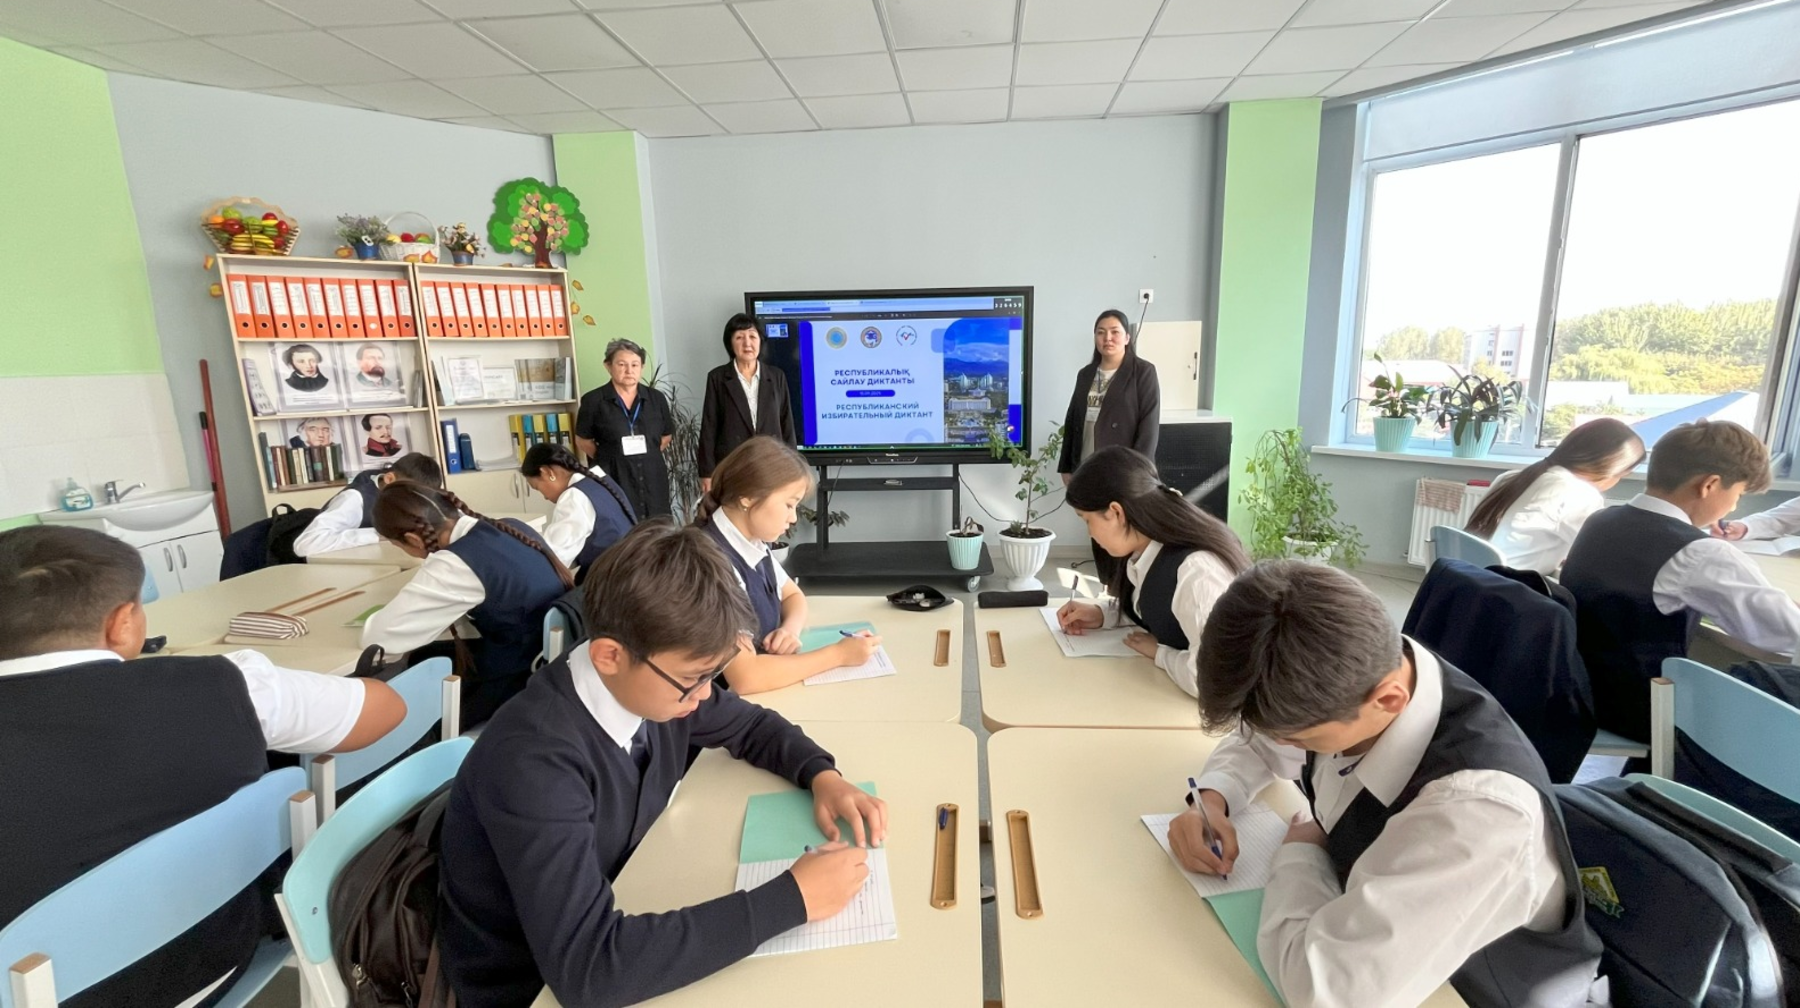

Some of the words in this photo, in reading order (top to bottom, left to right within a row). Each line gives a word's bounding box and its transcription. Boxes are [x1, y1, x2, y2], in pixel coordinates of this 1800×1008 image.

[836, 402, 919, 410] РЕСПУБЛИКАНСКИЙ
[821, 411, 893, 419] ИЗБИРАТЕЛЬНЫЙ
[894, 411, 934, 419] ДИКТАНТ
